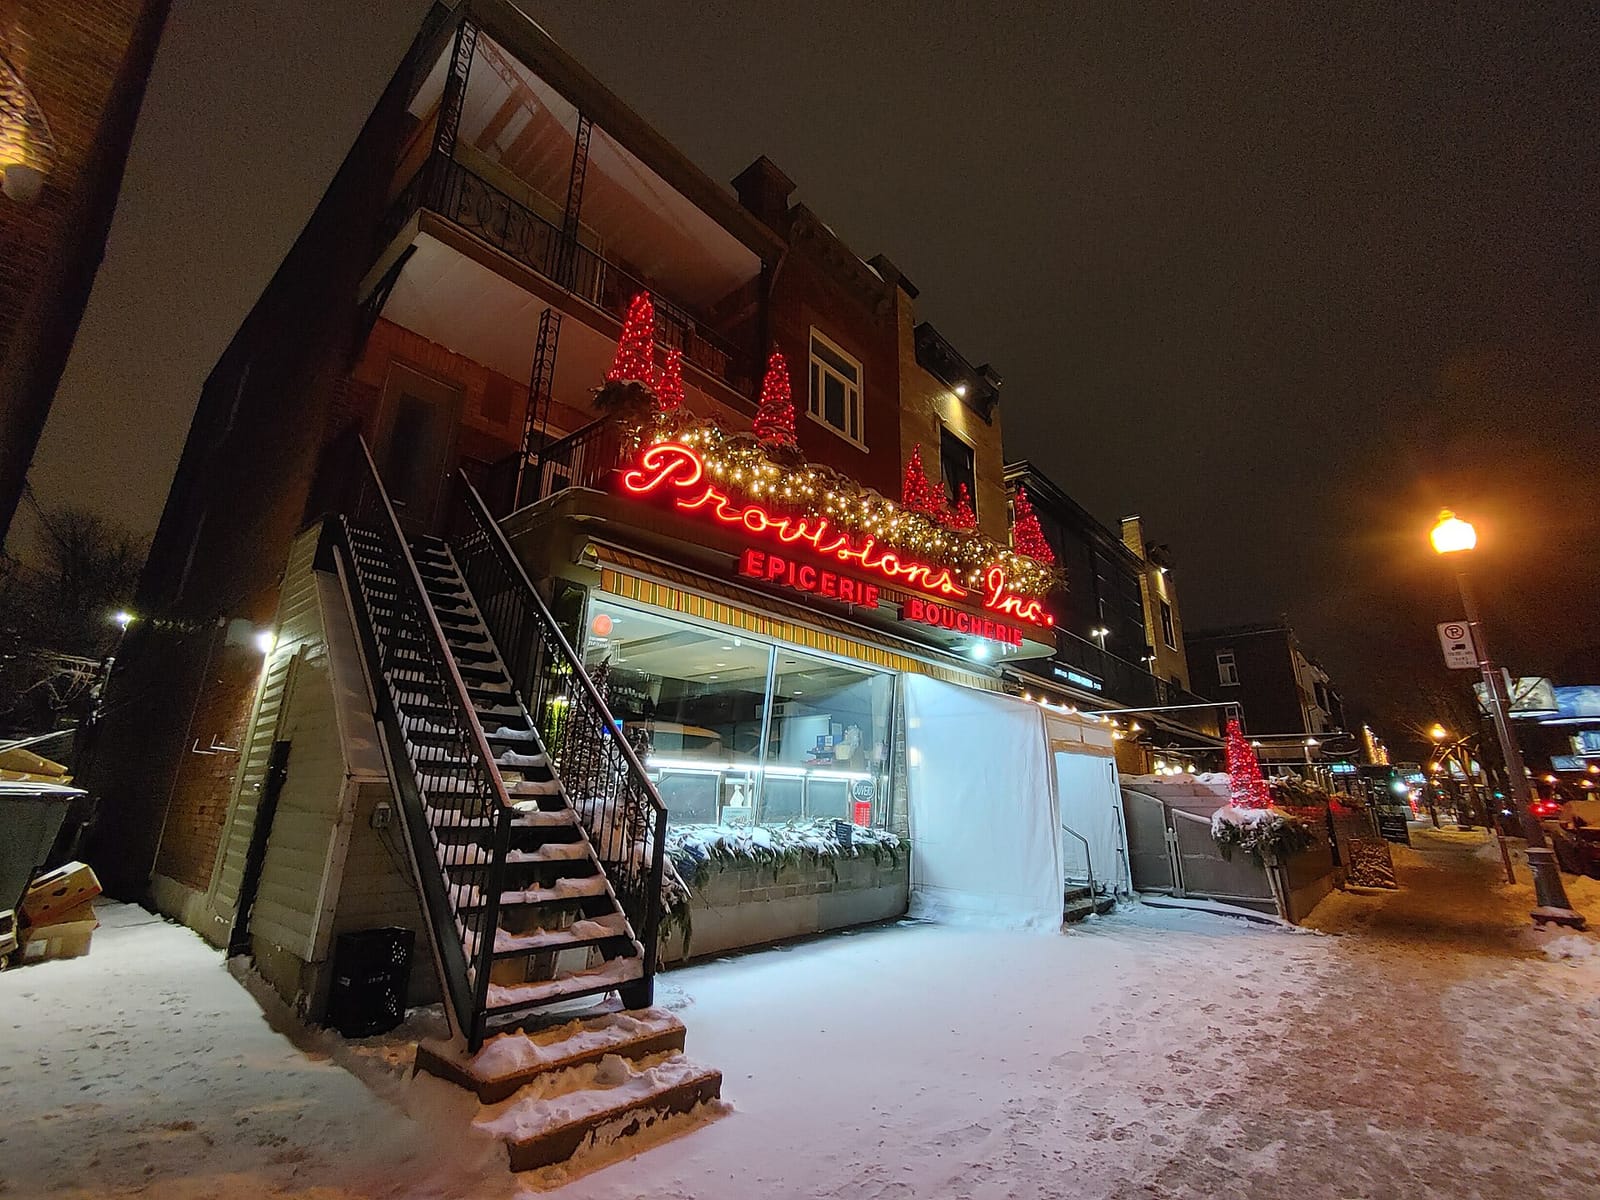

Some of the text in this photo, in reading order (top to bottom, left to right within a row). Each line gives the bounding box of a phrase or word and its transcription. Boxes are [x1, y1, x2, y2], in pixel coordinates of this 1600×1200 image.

[624, 442, 968, 597] Provisions
[744, 549, 880, 609] EPICERIE
[910, 599, 1024, 647] BOUCHERIE
